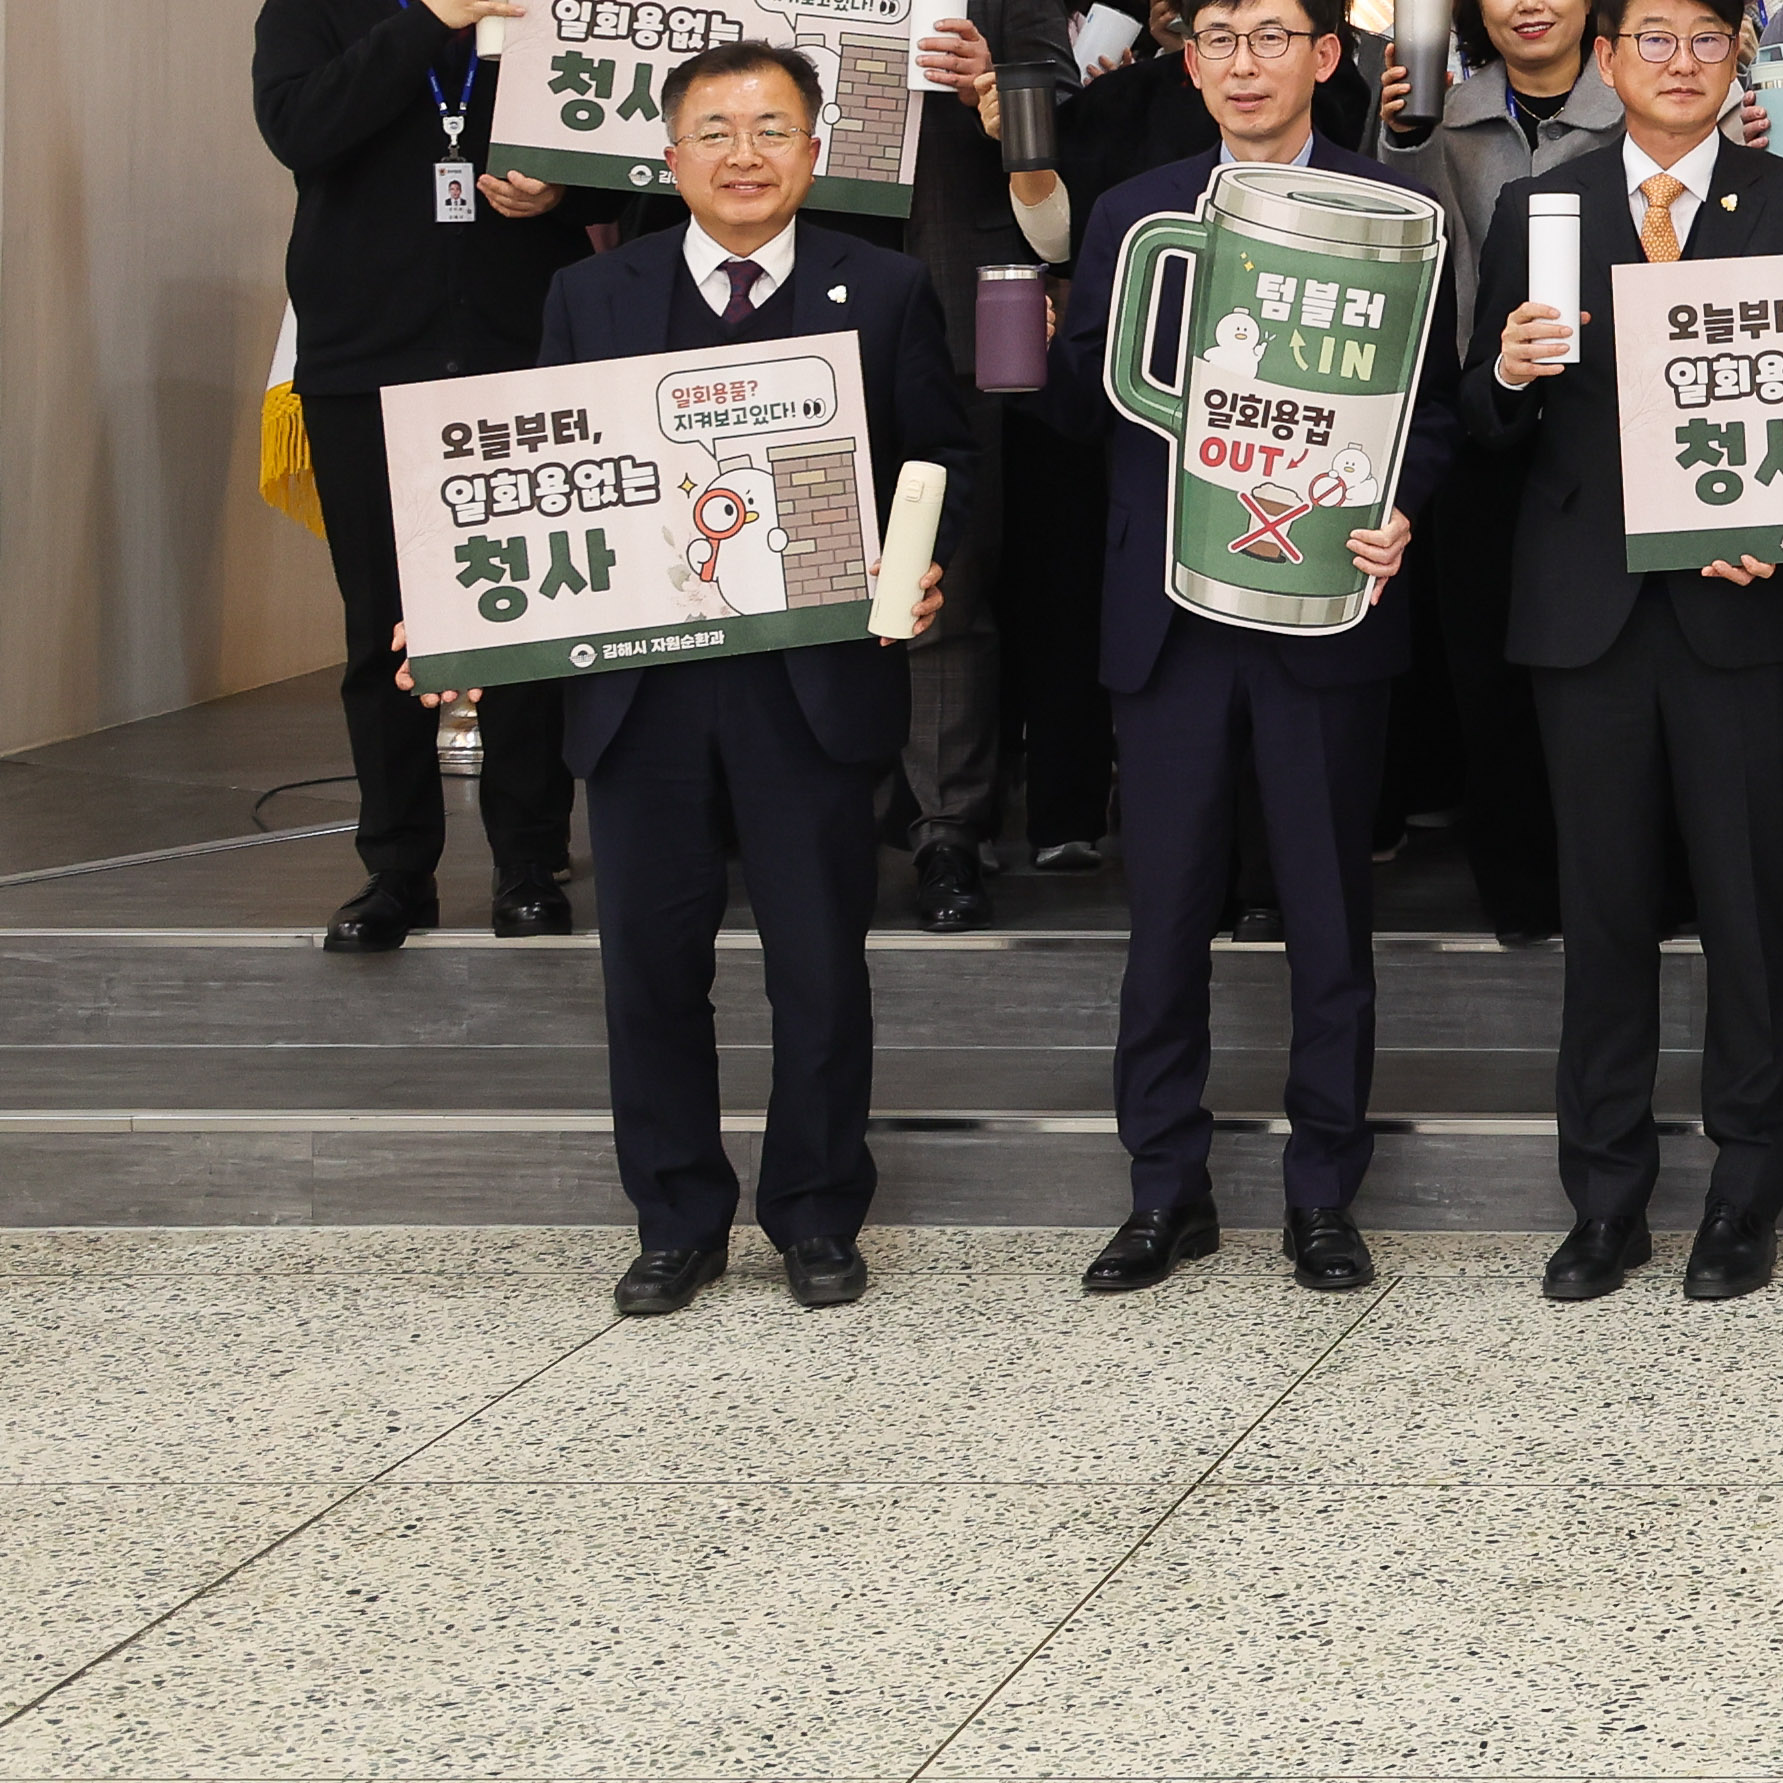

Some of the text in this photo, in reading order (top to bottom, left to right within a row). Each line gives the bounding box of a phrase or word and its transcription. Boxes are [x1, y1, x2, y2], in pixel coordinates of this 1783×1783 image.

[1255, 271, 1387, 330] 텀블러
[1317, 335, 1377, 382] IN
[671, 380, 759, 409] 일회용품?
[673, 401, 797, 432] 지켜보고있다!
[1203, 388, 1337, 447] 일회용컵
[441, 407, 603, 461] 오늘부터,
[1199, 436, 1285, 478] OUT
[441, 454, 660, 528] 일회용없는
[454, 527, 617, 624] 청사
[602, 629, 726, 661] 김해시 자원순환과
